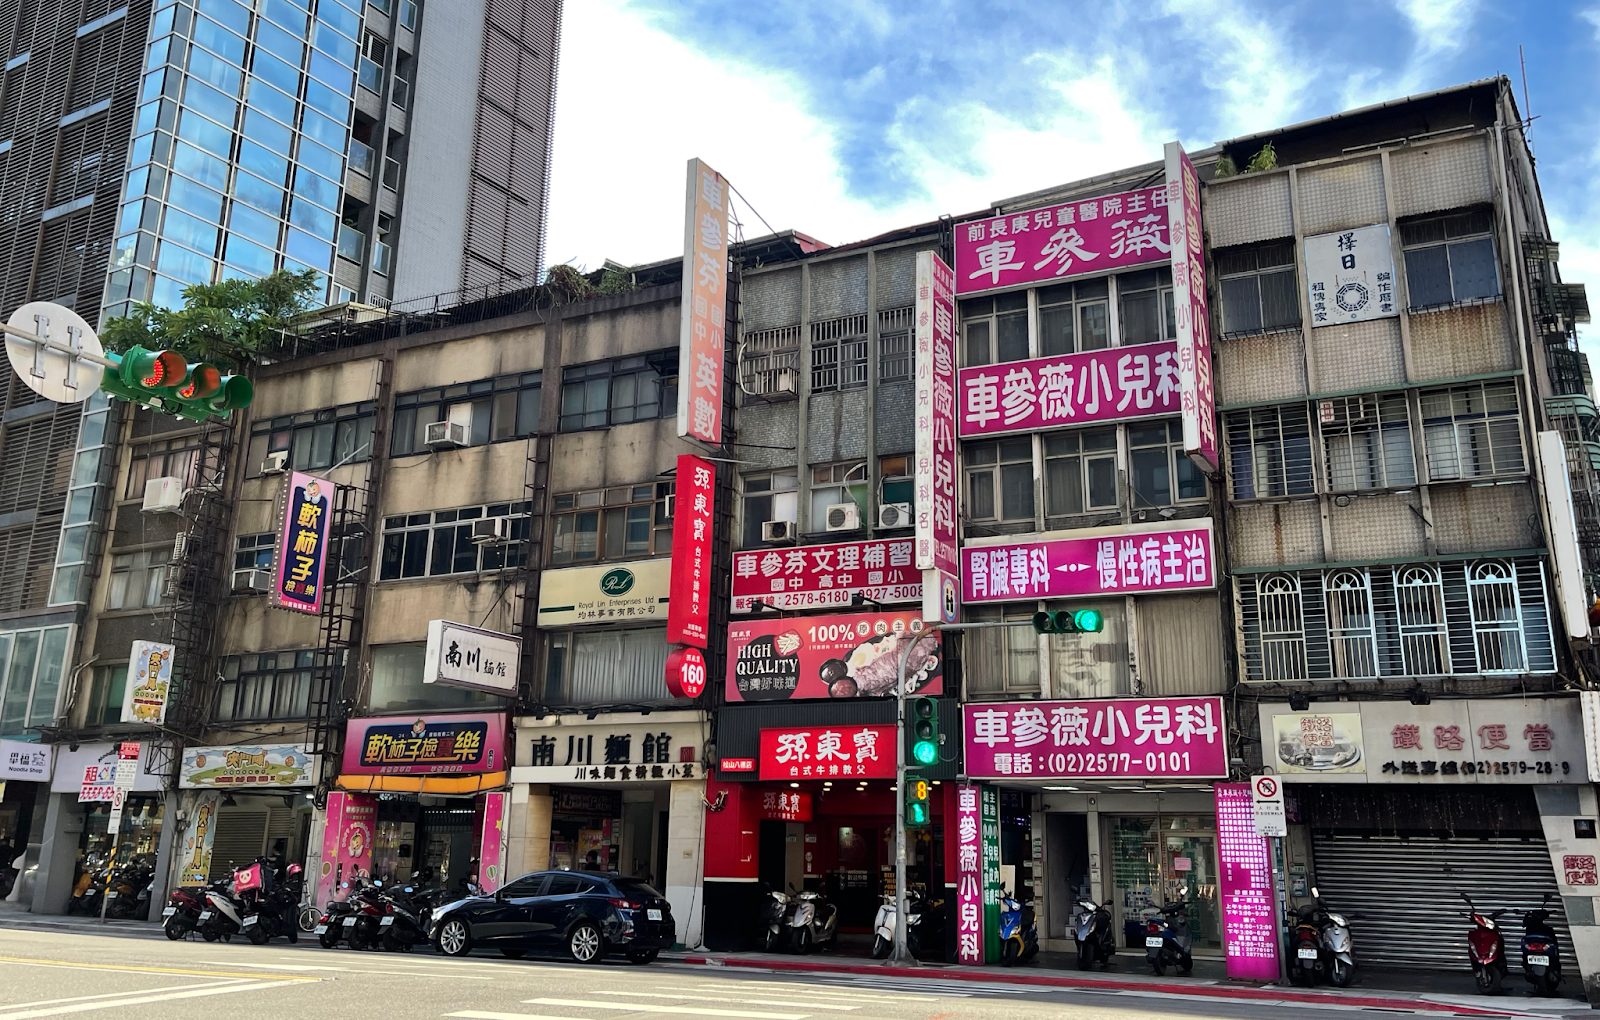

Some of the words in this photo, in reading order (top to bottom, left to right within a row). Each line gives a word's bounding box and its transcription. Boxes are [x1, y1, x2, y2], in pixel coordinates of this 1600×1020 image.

[967, 187, 1168, 243] 前長庚兒童醫院主任
[968, 213, 1171, 285] 車參薇
[1337, 232, 1358, 270] 擇日
[965, 351, 1181, 428] 車參薇小兒科
[291, 502, 322, 581] 軟柿子
[736, 541, 913, 579] 車參芬文理補習
[971, 545, 1050, 598] 腎臟專科
[1096, 533, 1206, 590] 慢性病主治
[771, 576, 804, 592] 國中
[818, 573, 853, 590] 高中
[868, 569, 904, 586] 國小
[578, 601, 594, 610] Royal
[609, 598, 642, 607] Enterprises
[784, 590, 849, 606] 2578-6180
[808, 624, 855, 643] 100%
[737, 643, 772, 659] HIGH
[681, 662, 704, 686] 160
[736, 658, 798, 675] QUALITY
[738, 676, 796, 692] 台灣好味道
[972, 702, 1218, 748] 車參薇小兒科
[1391, 723, 1555, 751] 鐵路便當
[531, 732, 673, 767] 南川麵館
[85, 766, 98, 781] 租
[789, 764, 866, 777] 台式牛排教父
[958, 788, 980, 962] 車參薇小兒科
